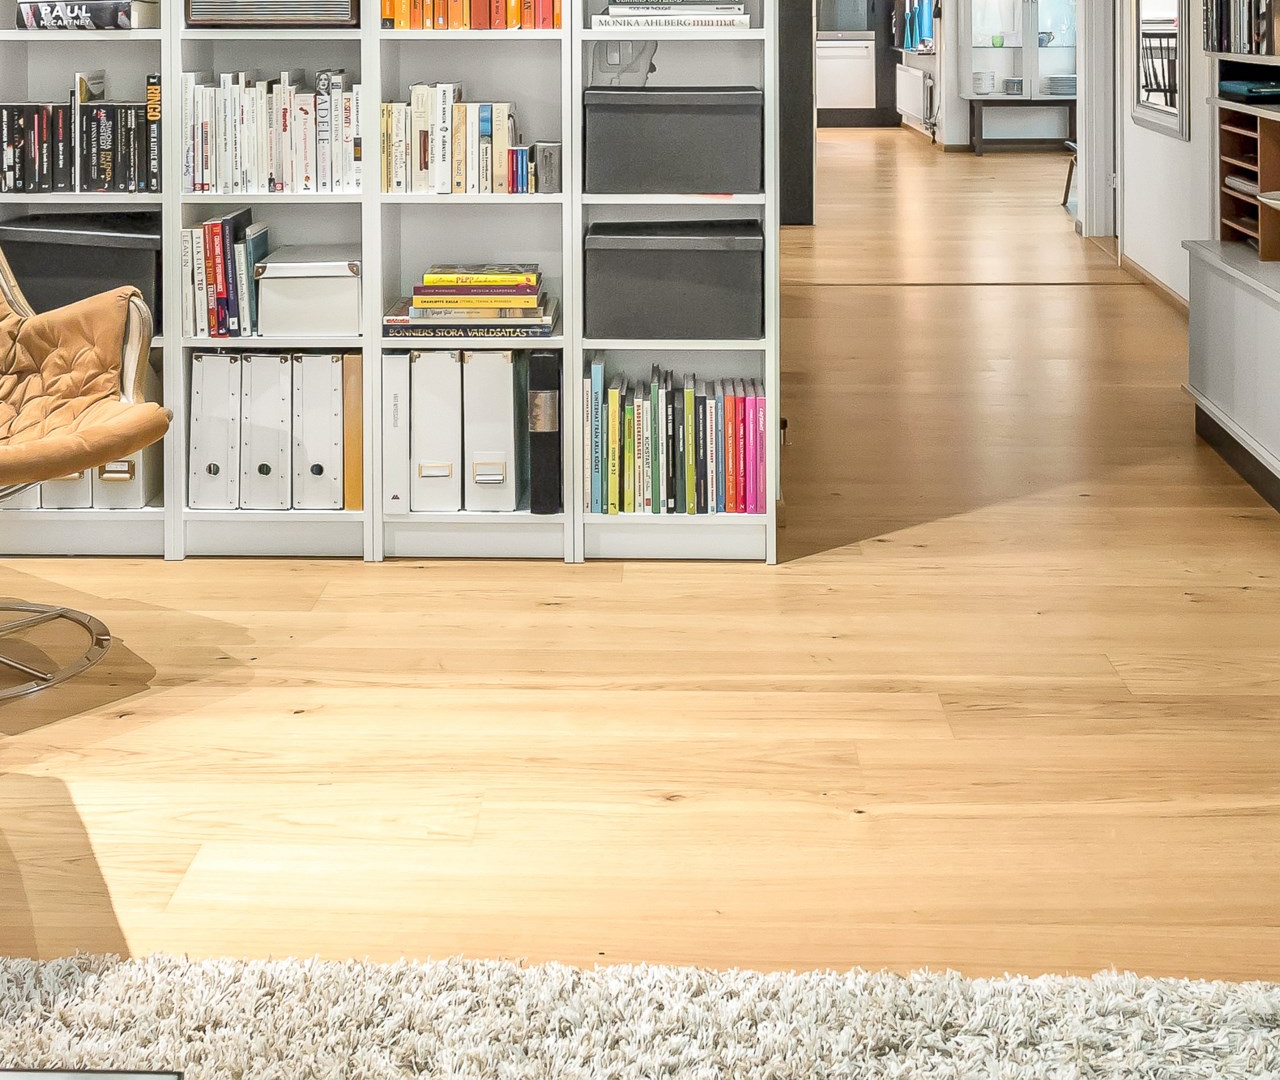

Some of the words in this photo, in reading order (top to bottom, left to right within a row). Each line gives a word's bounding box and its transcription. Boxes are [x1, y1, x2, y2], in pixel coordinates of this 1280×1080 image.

[41, 5, 91, 17] PAUL
[40, 19, 91, 27] McCARTNEY
[147, 86, 161, 121] RINGO
[318, 97, 329, 145] ADELE
[183, 259, 189, 267] IN
[467, 328, 527, 336] VÄRLDSATLAS
